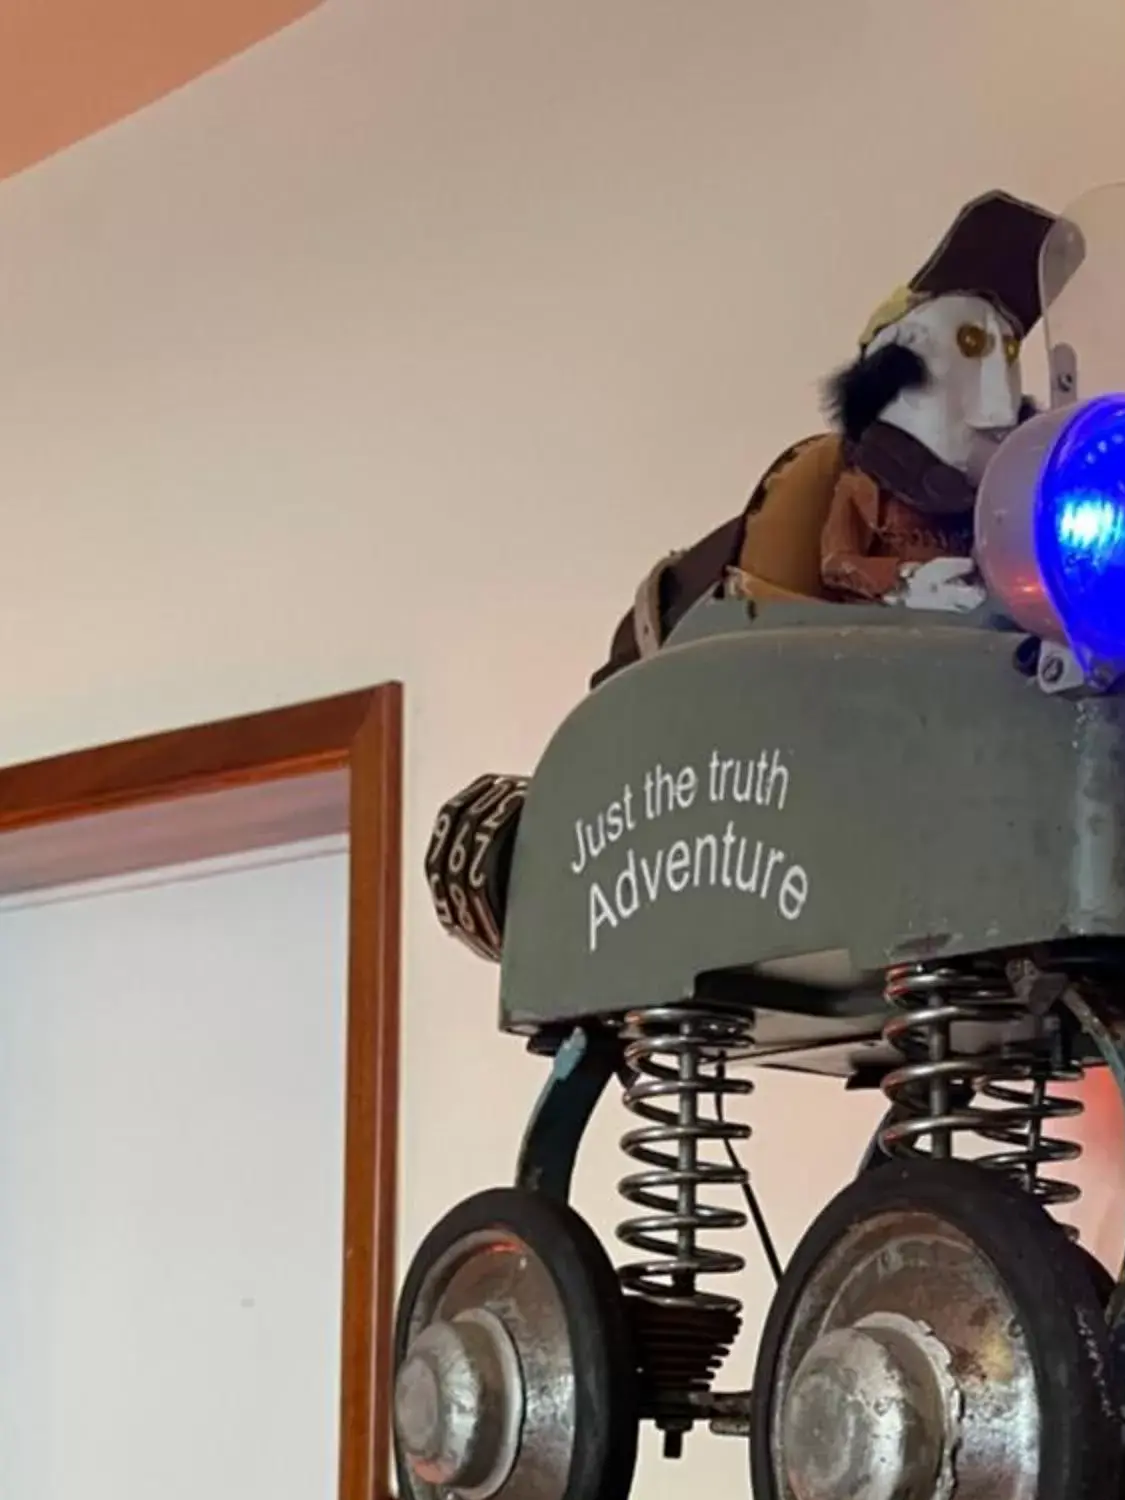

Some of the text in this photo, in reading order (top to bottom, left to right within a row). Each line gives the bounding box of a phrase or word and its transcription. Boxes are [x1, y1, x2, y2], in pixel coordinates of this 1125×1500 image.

[571, 747, 790, 874] Just the truth
[588, 820, 809, 952] Adventure
